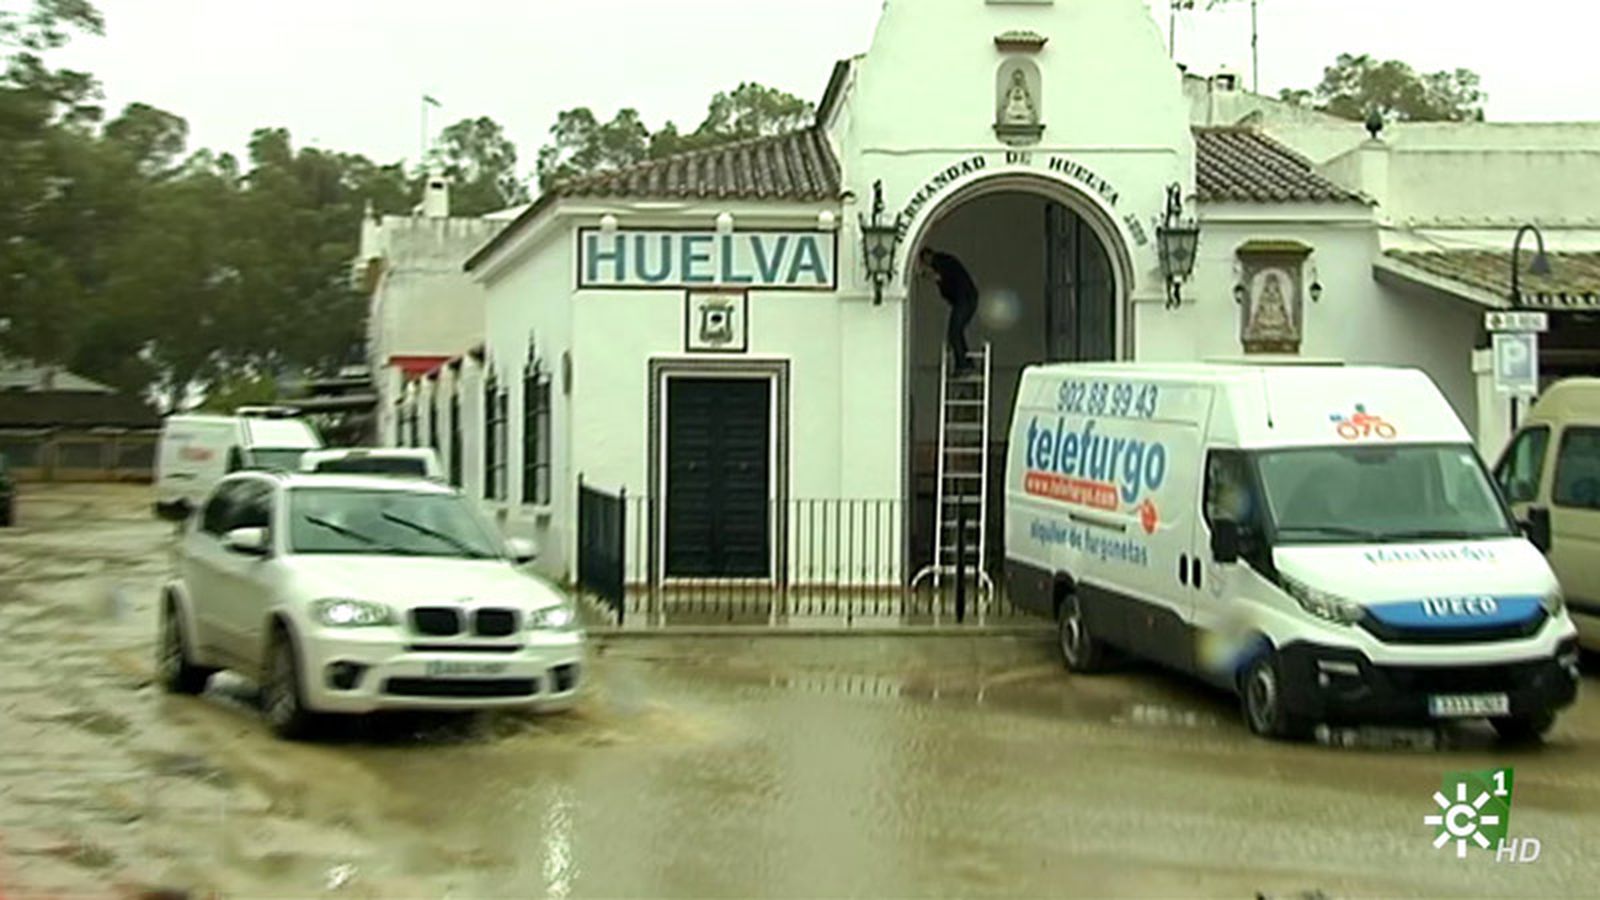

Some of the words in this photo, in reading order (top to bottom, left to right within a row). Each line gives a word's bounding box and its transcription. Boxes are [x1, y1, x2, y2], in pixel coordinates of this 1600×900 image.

[1005, 150, 1032, 165] DE
[1048, 156, 1119, 206] HUELVA
[587, 234, 828, 283] HUELVA
[1502, 341, 1528, 376] P
[1057, 380, 1085, 412] 902
[1087, 381, 1109, 415] 88
[1111, 382, 1133, 417] 99
[1134, 383, 1158, 418] 43
[1026, 415, 1166, 504] telefurgo
[1069, 526, 1083, 548] de
[1084, 528, 1148, 567] furgonetas
[1421, 595, 1499, 617] IVECO
